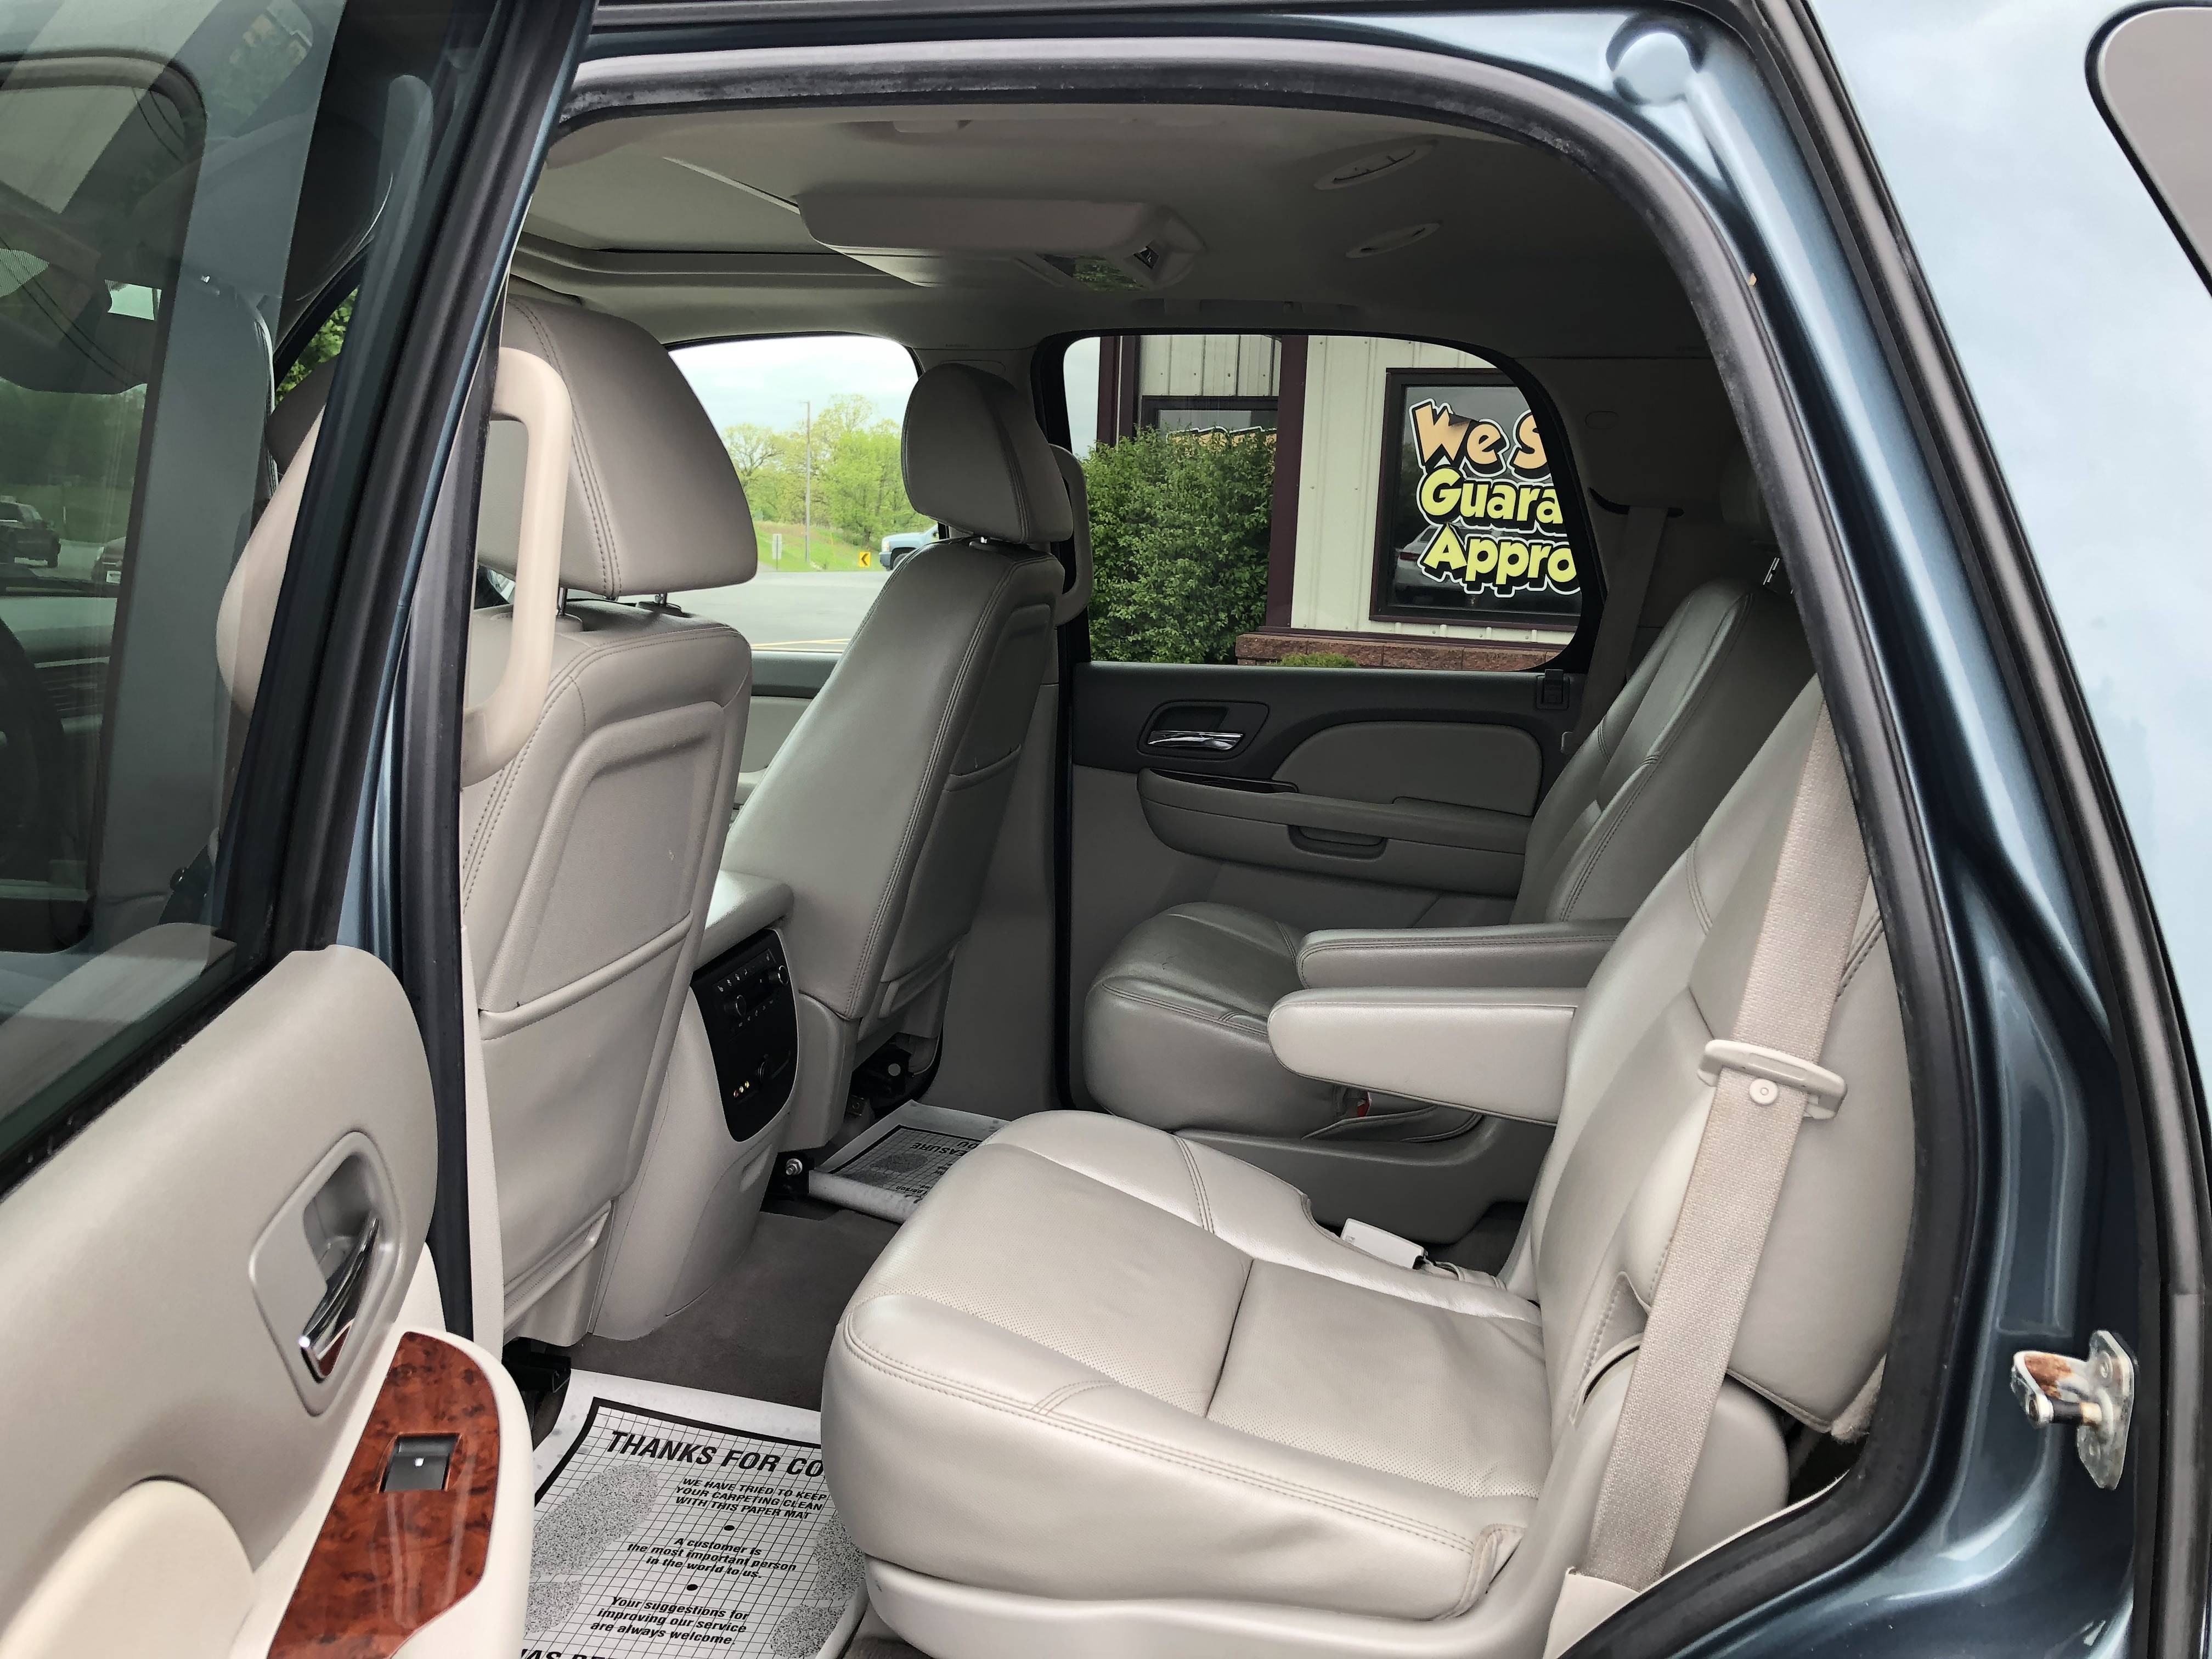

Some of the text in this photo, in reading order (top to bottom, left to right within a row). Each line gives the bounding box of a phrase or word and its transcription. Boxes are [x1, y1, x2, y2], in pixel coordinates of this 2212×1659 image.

[1410, 400, 1508, 474] We
[1419, 523, 1579, 595] Appro
[607, 1431, 825, 1477] THANKS FOR CO
[676, 1486, 823, 1511] YOUR CARPETING CLEAN
[683, 1479, 827, 1501] WE HAVE TRIED TO KEEP
[676, 1497, 812, 1519] WITH THIS PAPER MAT
[627, 1543, 797, 1571] the most important person
[686, 1540, 748, 1553] customer
[749, 1547, 762, 1555] is
[646, 1556, 762, 1578] in the world to us.
[612, 1596, 750, 1620] Your suggestions for
[596, 1608, 747, 1633] improving our service
[590, 1622, 735, 1645] are always welcome.
